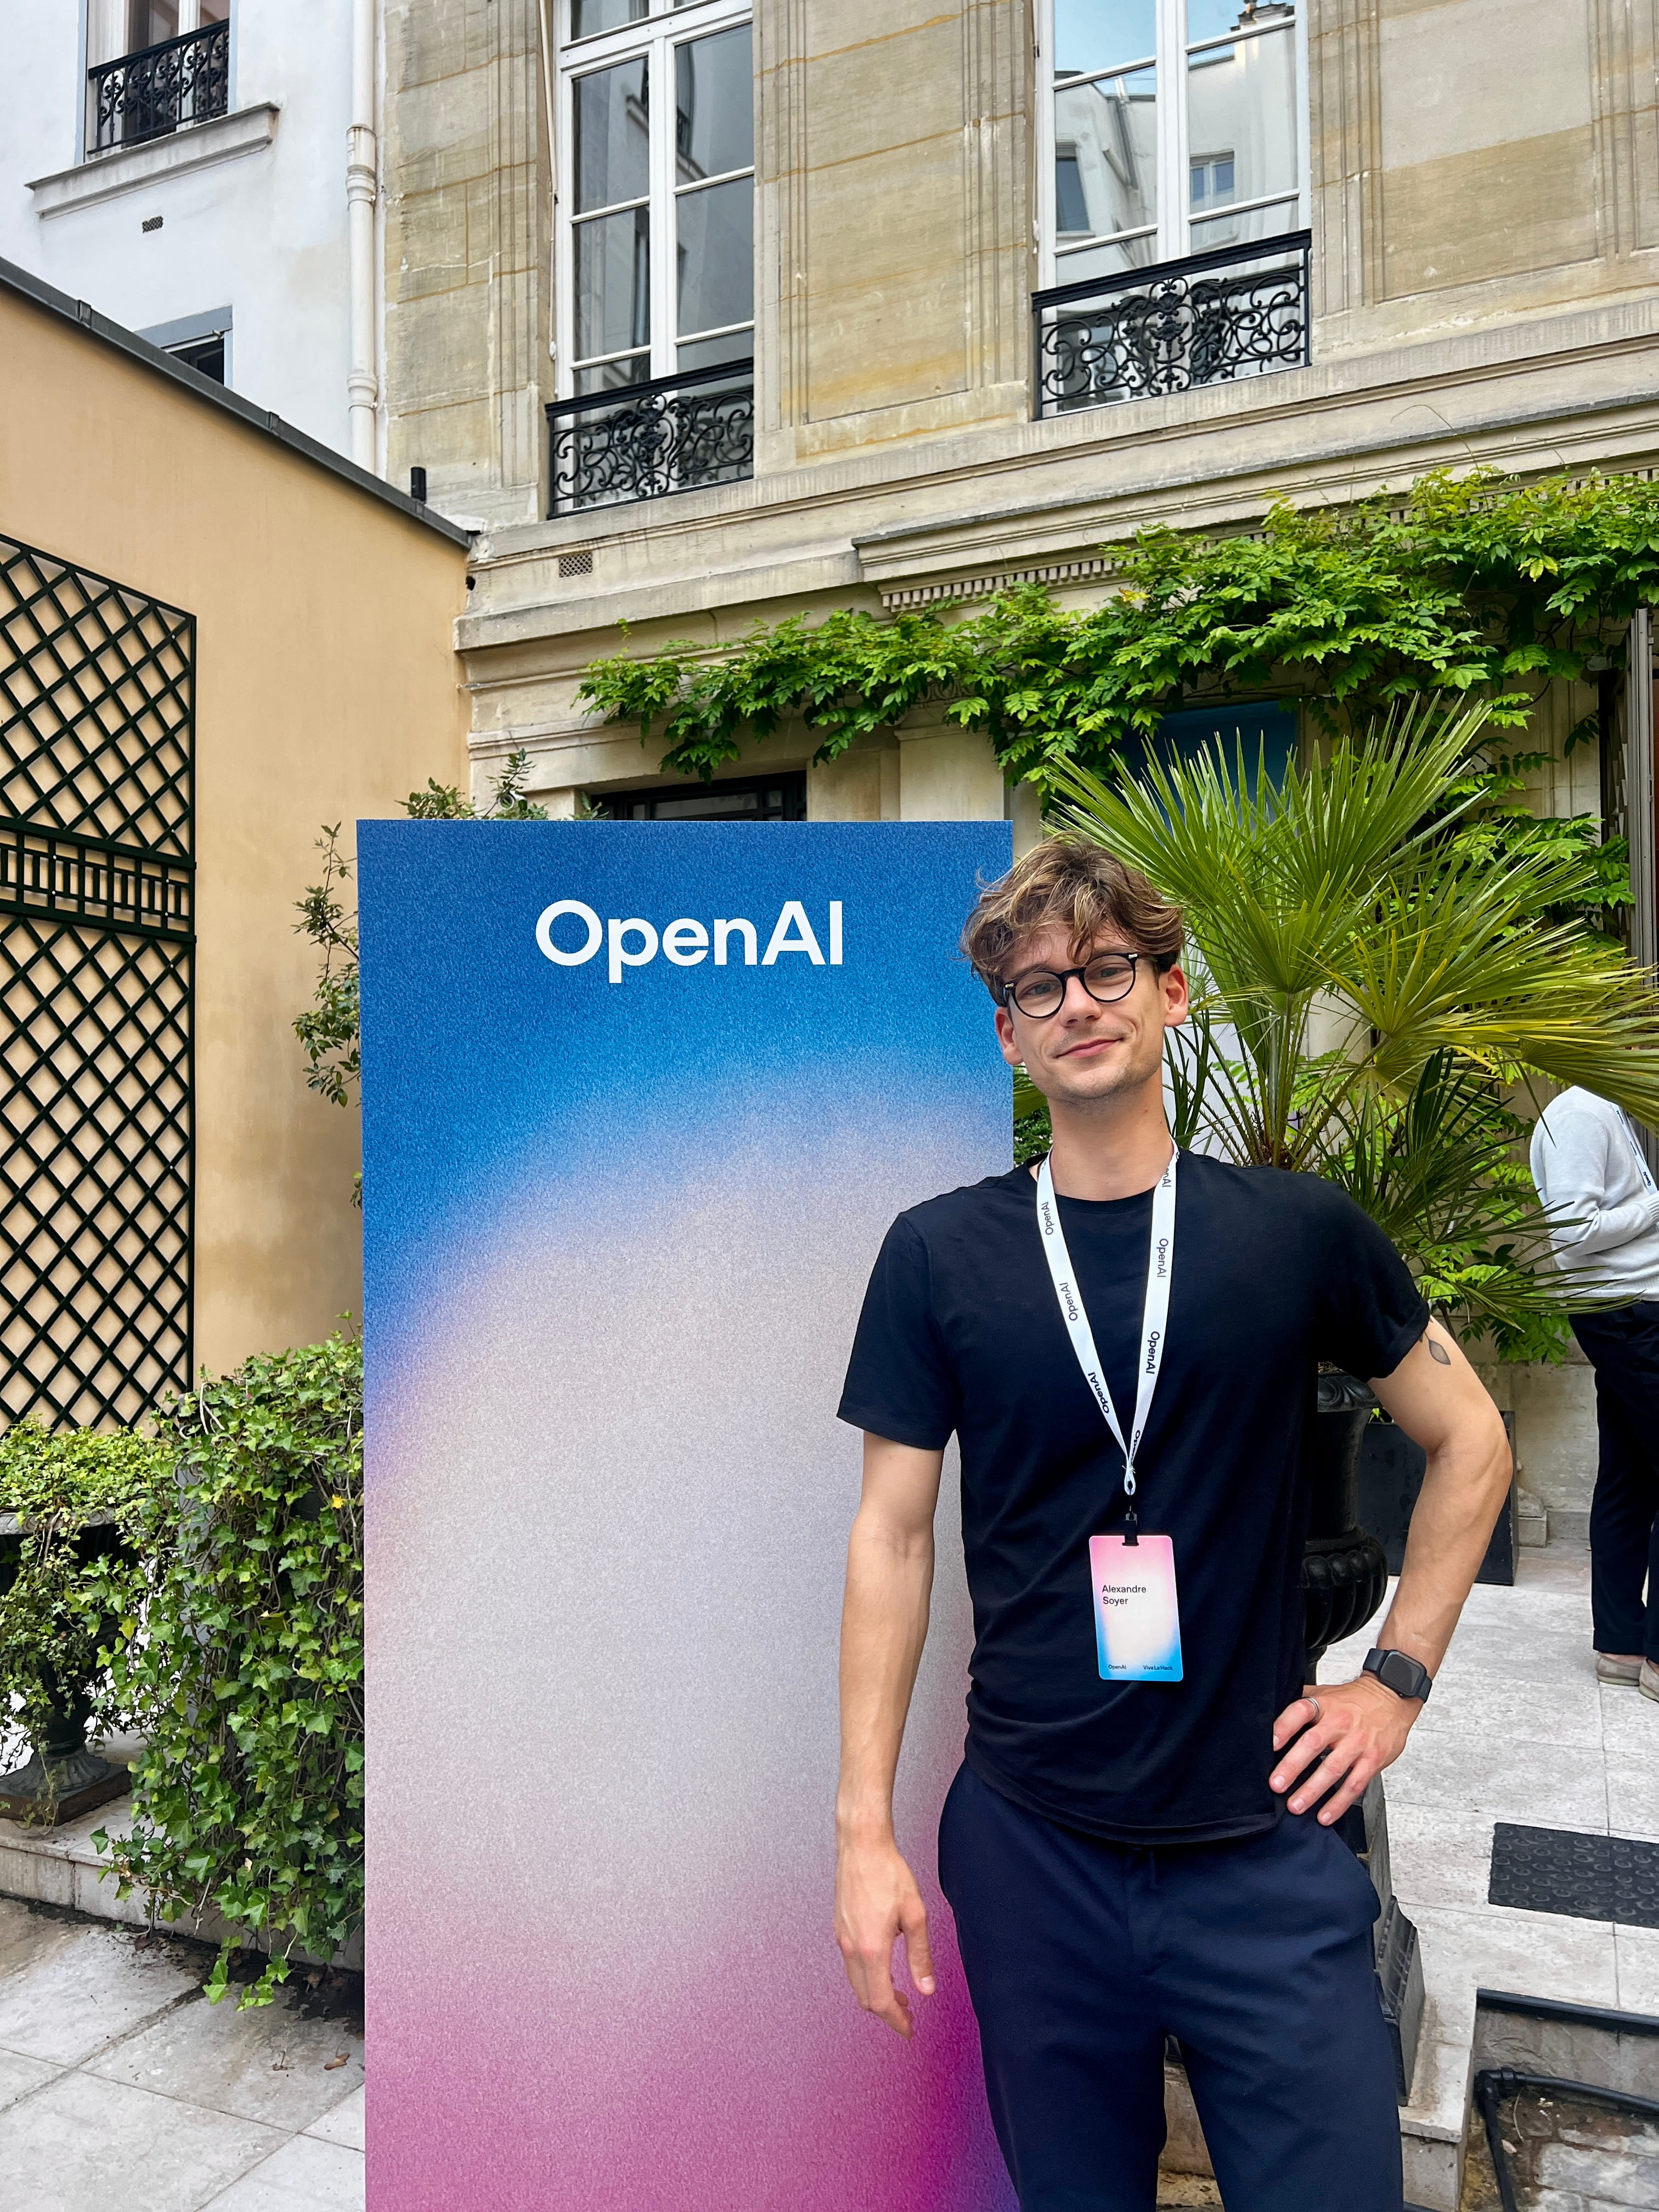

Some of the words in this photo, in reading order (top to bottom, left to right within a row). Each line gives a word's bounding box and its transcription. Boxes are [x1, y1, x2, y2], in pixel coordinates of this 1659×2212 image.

[535, 899, 843, 983] OpenAI
[1162, 1167, 1172, 1188] enAI
[1041, 1201, 1055, 1235] OpenAI
[1156, 1238, 1169, 1278] OpenAI
[1059, 1282, 1079, 1321] OpenAI
[1146, 1331, 1160, 1374] OpenAI
[1087, 1372, 1109, 1414] OpenAI
[1102, 1584, 1147, 1593] Alexandre
[1103, 1596, 1128, 1607] Soyer
